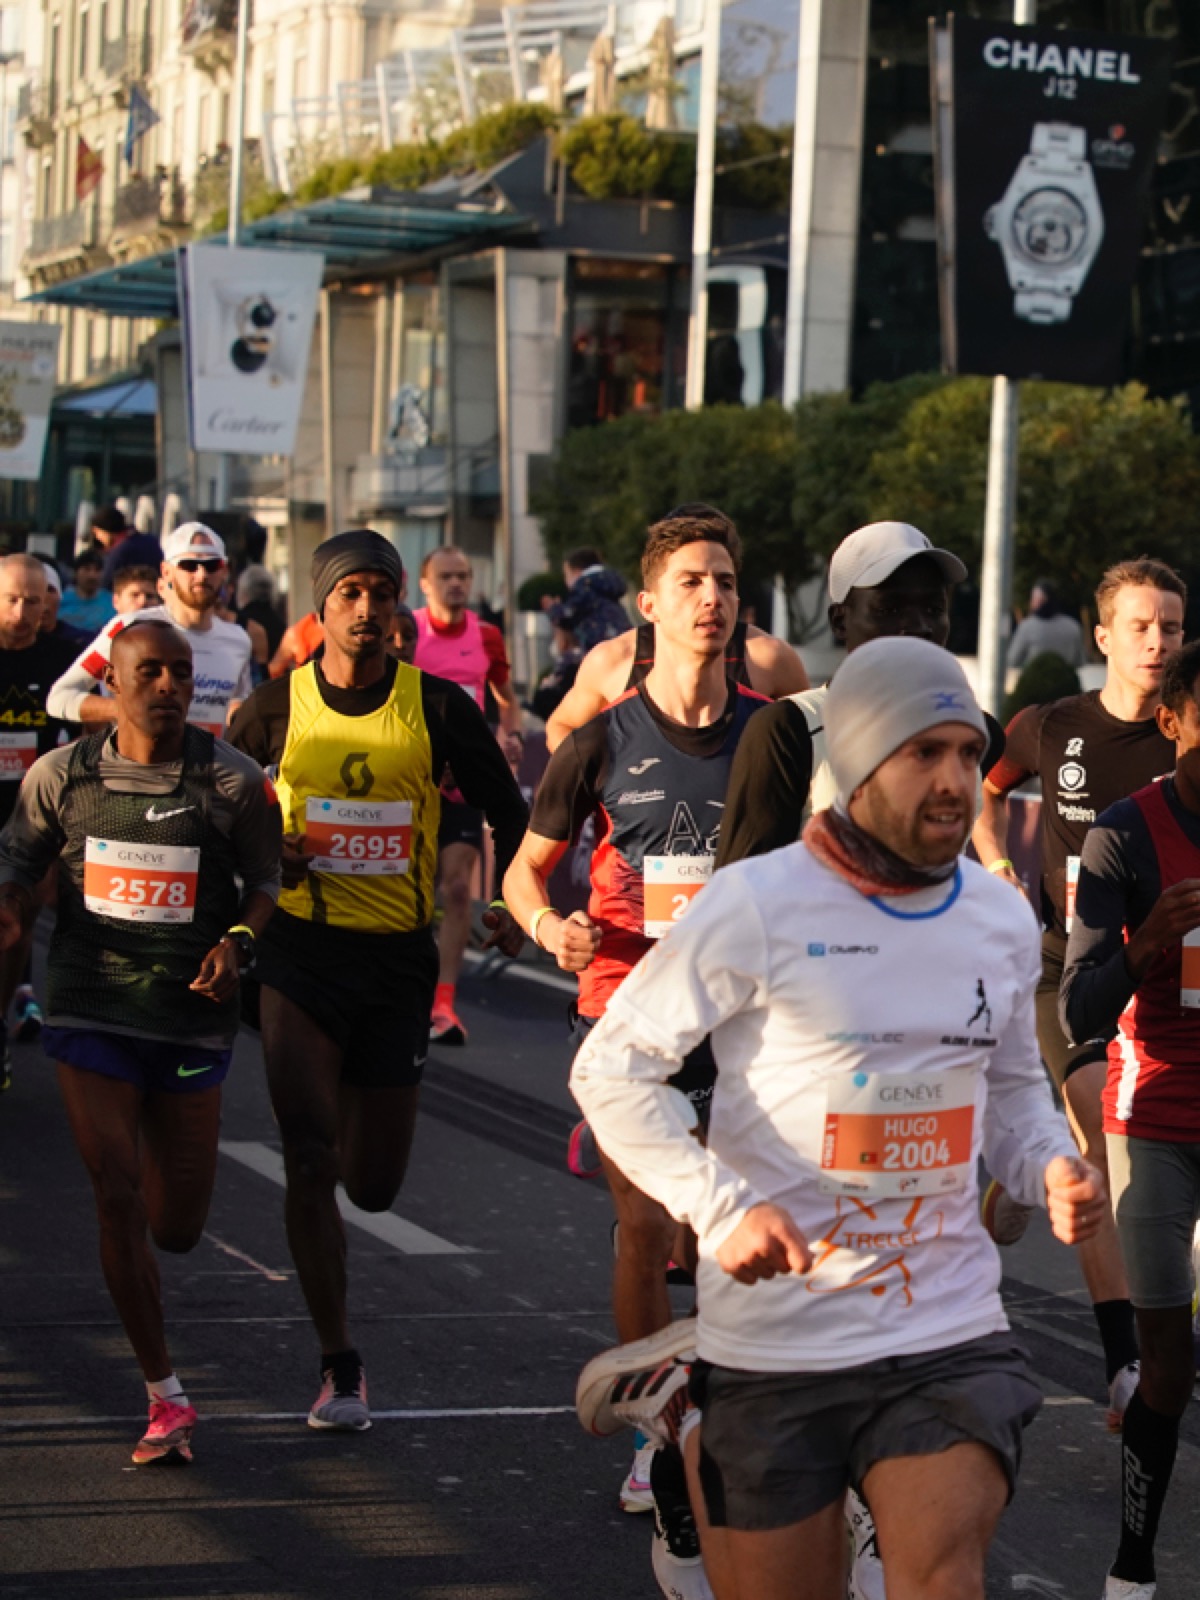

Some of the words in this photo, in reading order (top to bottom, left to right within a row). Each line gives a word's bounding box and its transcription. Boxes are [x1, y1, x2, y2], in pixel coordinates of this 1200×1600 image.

[976, 37, 1141, 84] CHANEL
[1043, 75, 1077, 99] J12
[207, 407, 284, 434] Cartier
[329, 833, 402, 859] 2695
[108, 876, 187, 906] 2578
[879, 1083, 943, 1101] GENÈVE
[884, 1117, 938, 1136] HUGO
[882, 1138, 949, 1169] 2004
